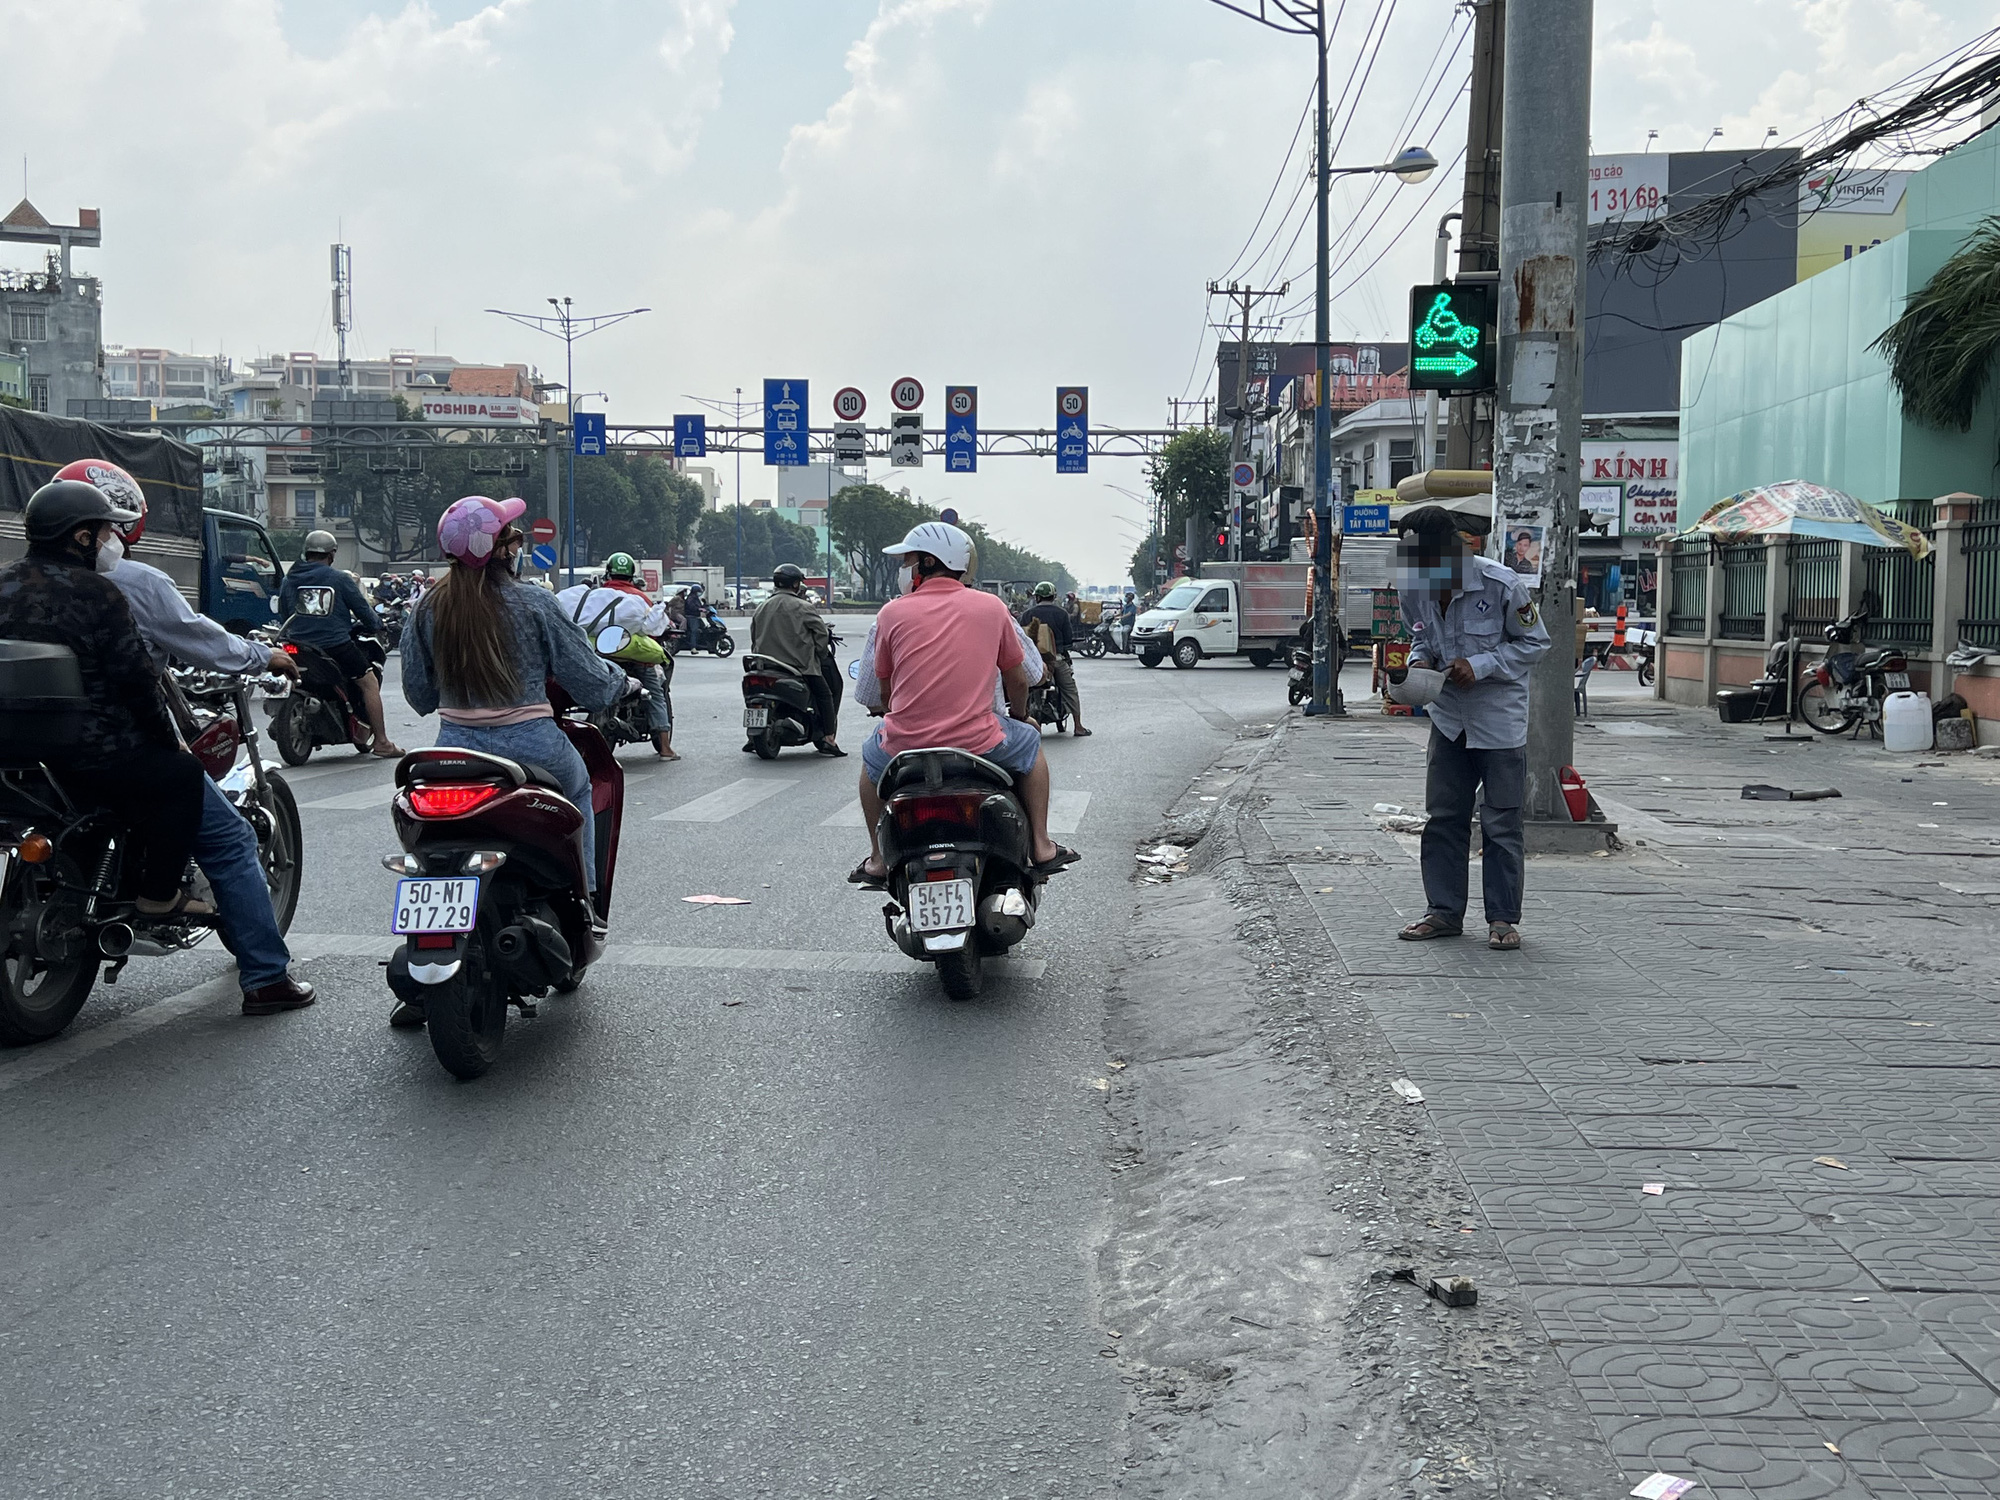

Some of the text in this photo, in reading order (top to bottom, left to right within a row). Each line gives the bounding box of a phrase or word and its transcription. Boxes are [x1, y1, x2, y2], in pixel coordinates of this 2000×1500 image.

[1604, 163, 1623, 177] cáo
[1835, 185, 1885, 196] VINAMA
[900, 387, 915, 402] 60
[424, 403, 488, 415] TOSHIBA
[843, 396, 857, 411] 80
[955, 396, 967, 409] 50
[1066, 397, 1078, 410] 50
[1594, 451, 1668, 479] KÍNH
[1354, 508, 1379, 516] ĐƯỜNG
[1350, 517, 1385, 530] TÂY THẠNH
[746, 718, 764, 726] 5170
[526, 797, 559, 813] Janus
[409, 882, 464, 904] 50-N1
[398, 906, 470, 930] 917.29
[920, 905, 965, 927] 5572
